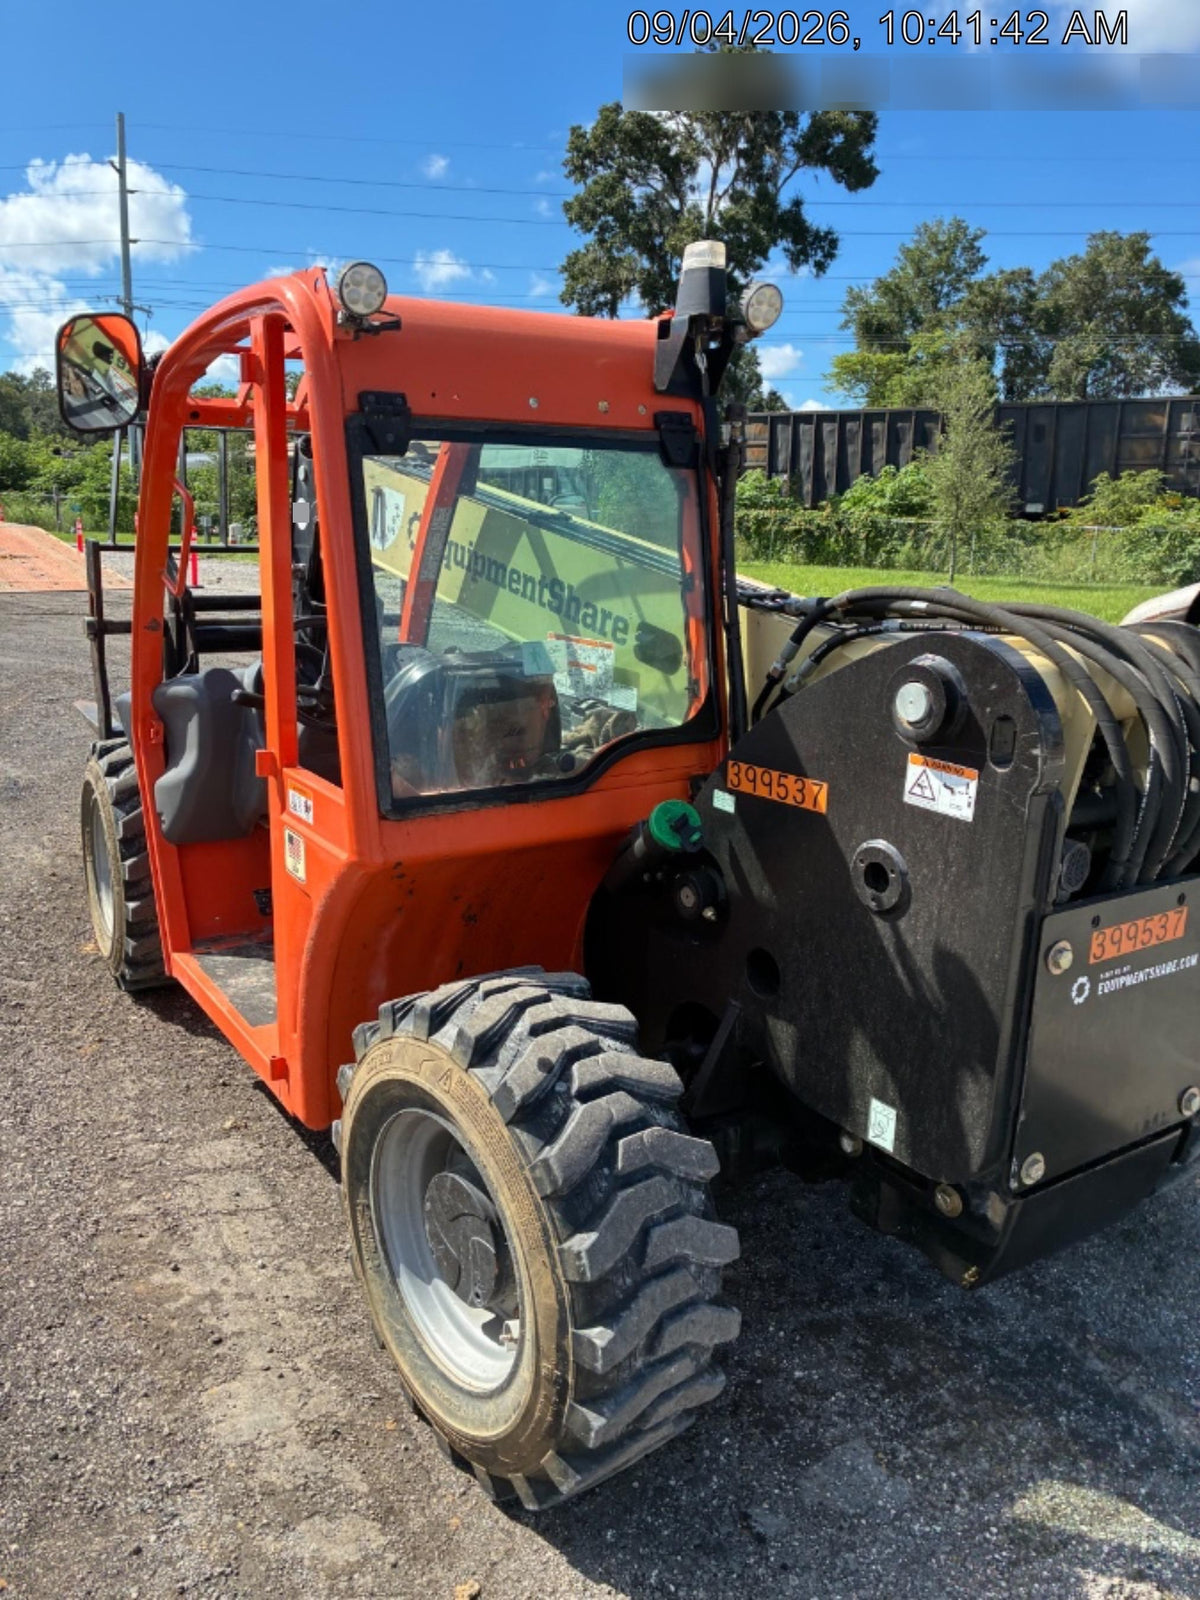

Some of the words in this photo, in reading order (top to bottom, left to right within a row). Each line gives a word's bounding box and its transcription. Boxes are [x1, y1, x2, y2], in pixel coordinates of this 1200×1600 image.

[442, 539, 630, 647] quipmentShare
[730, 761, 825, 809] 399537
[1093, 908, 1185, 960] 399537
[1098, 953, 1199, 995] EQUIPMENTSHARE.COM
